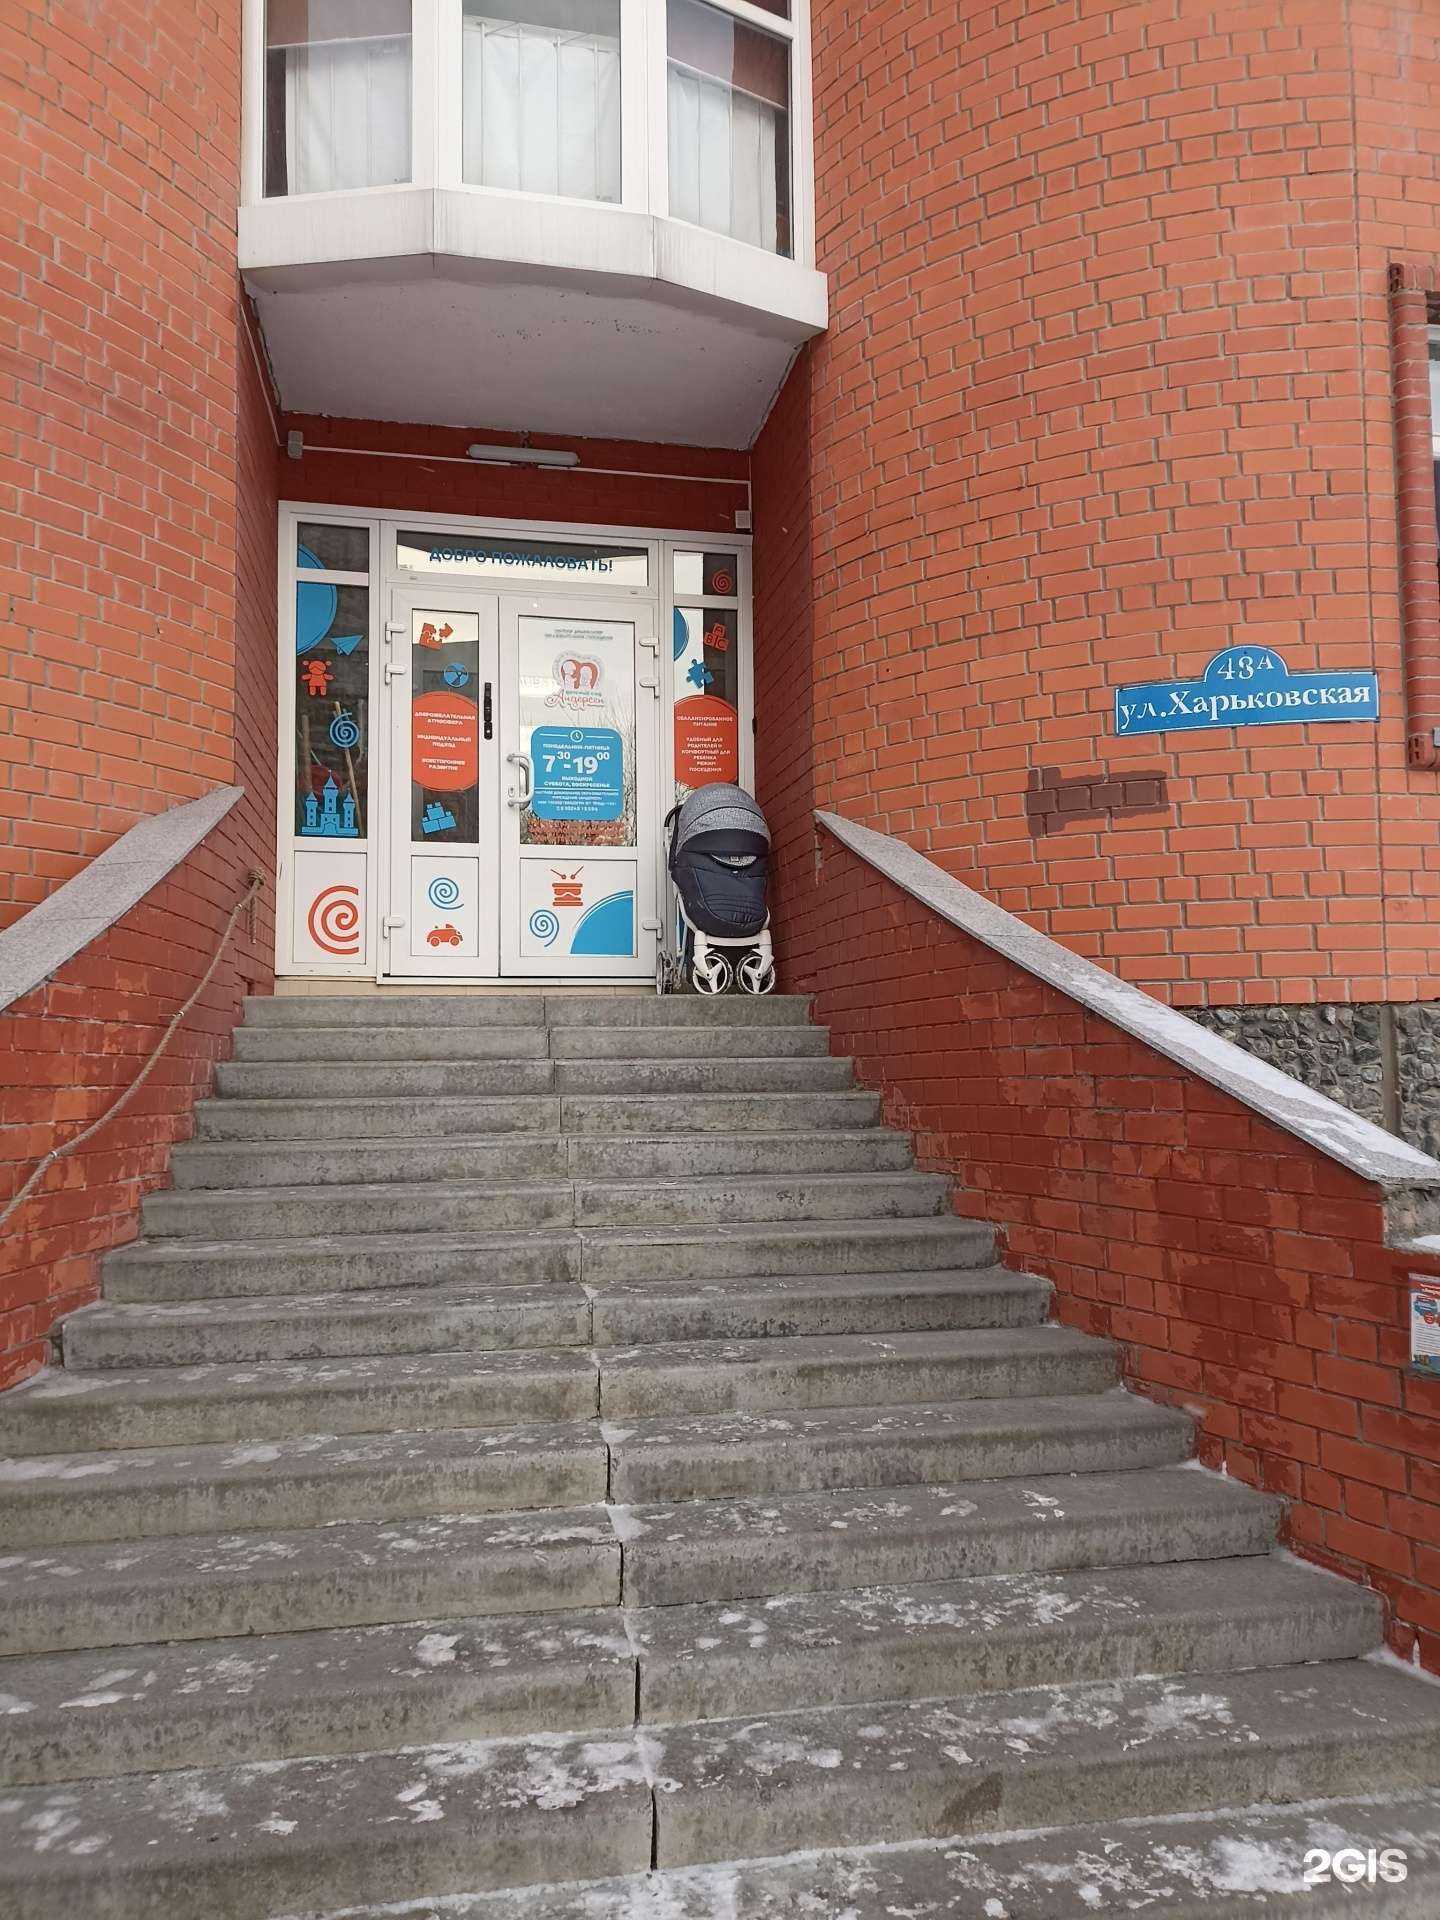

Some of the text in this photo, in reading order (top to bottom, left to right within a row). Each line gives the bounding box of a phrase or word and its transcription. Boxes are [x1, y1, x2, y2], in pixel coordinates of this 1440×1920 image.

[429, 547, 614, 572] ДОБРО ПОЖАЛОВАТЬ!
[1119, 685, 1371, 730] ул.Харьковская
